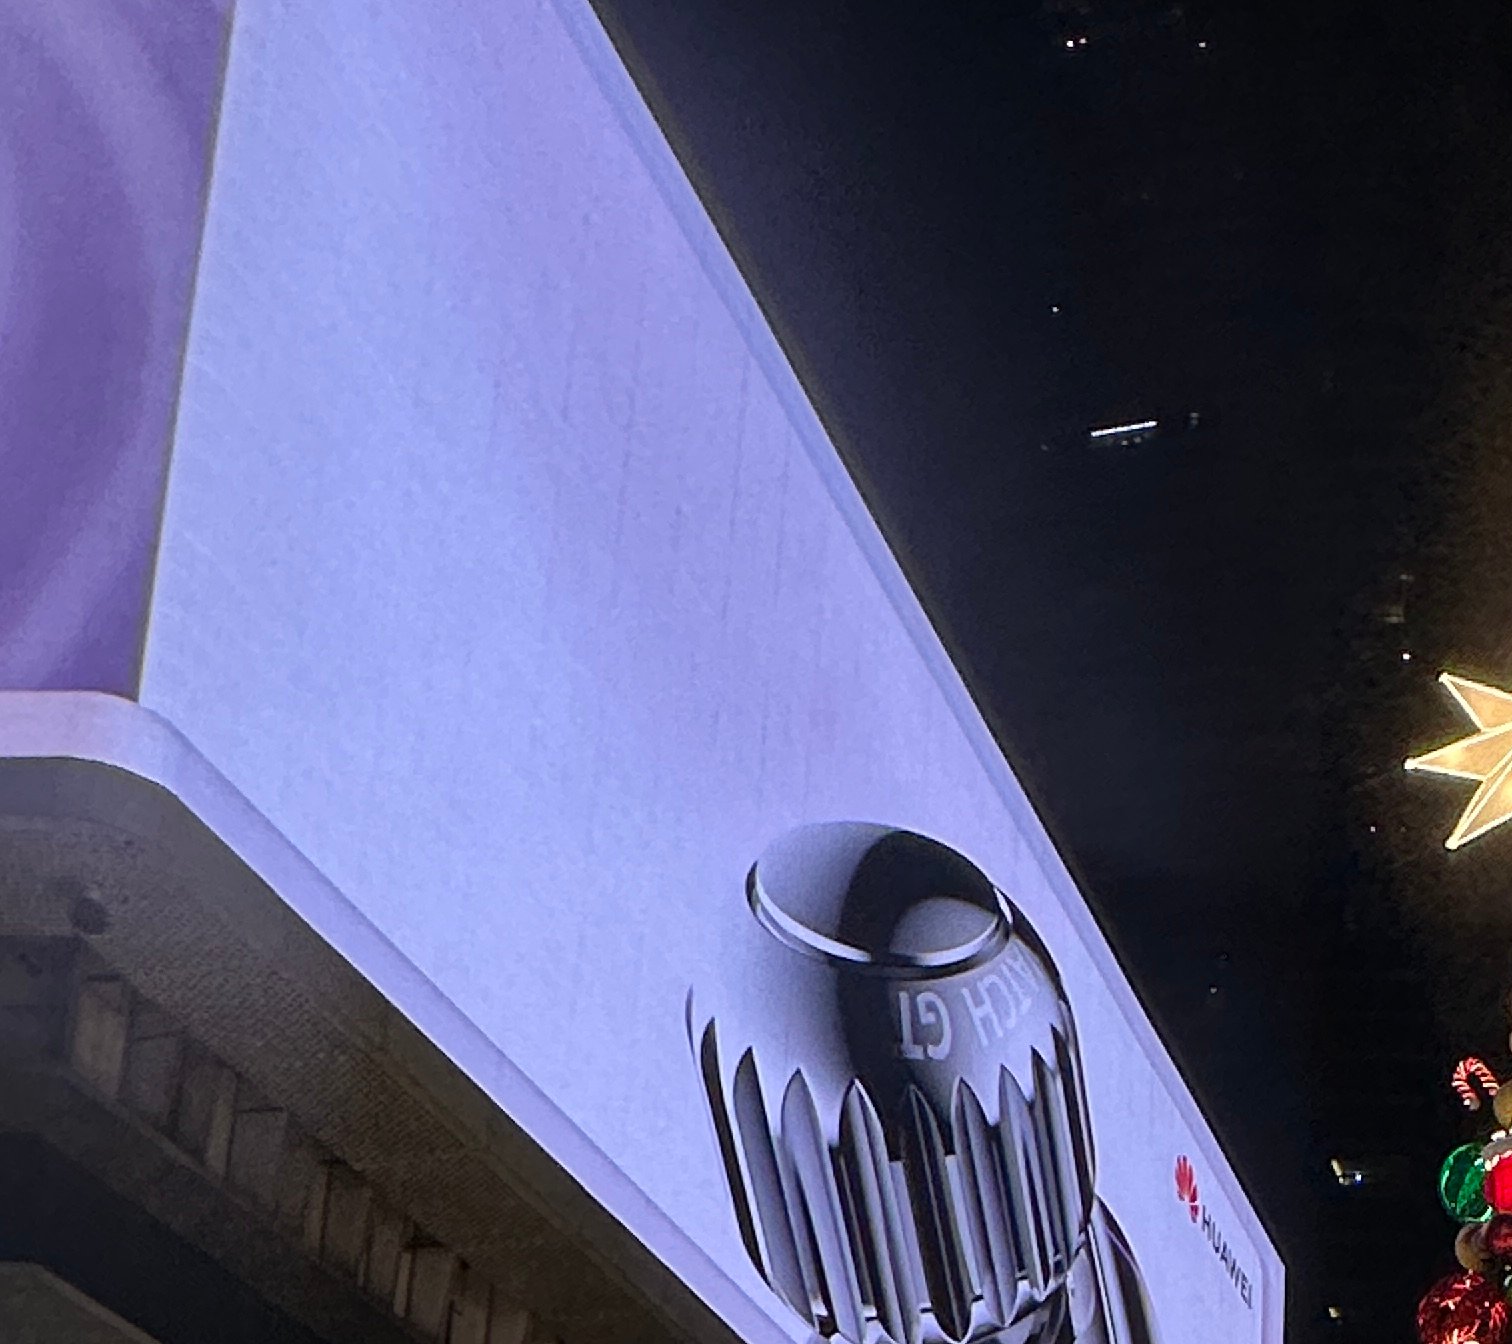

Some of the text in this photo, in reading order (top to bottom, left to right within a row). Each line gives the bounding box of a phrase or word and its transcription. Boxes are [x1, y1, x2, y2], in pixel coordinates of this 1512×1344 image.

[899, 943, 1041, 1060] ATCH GT
[1201, 1205, 1253, 1310] HUAWEI
